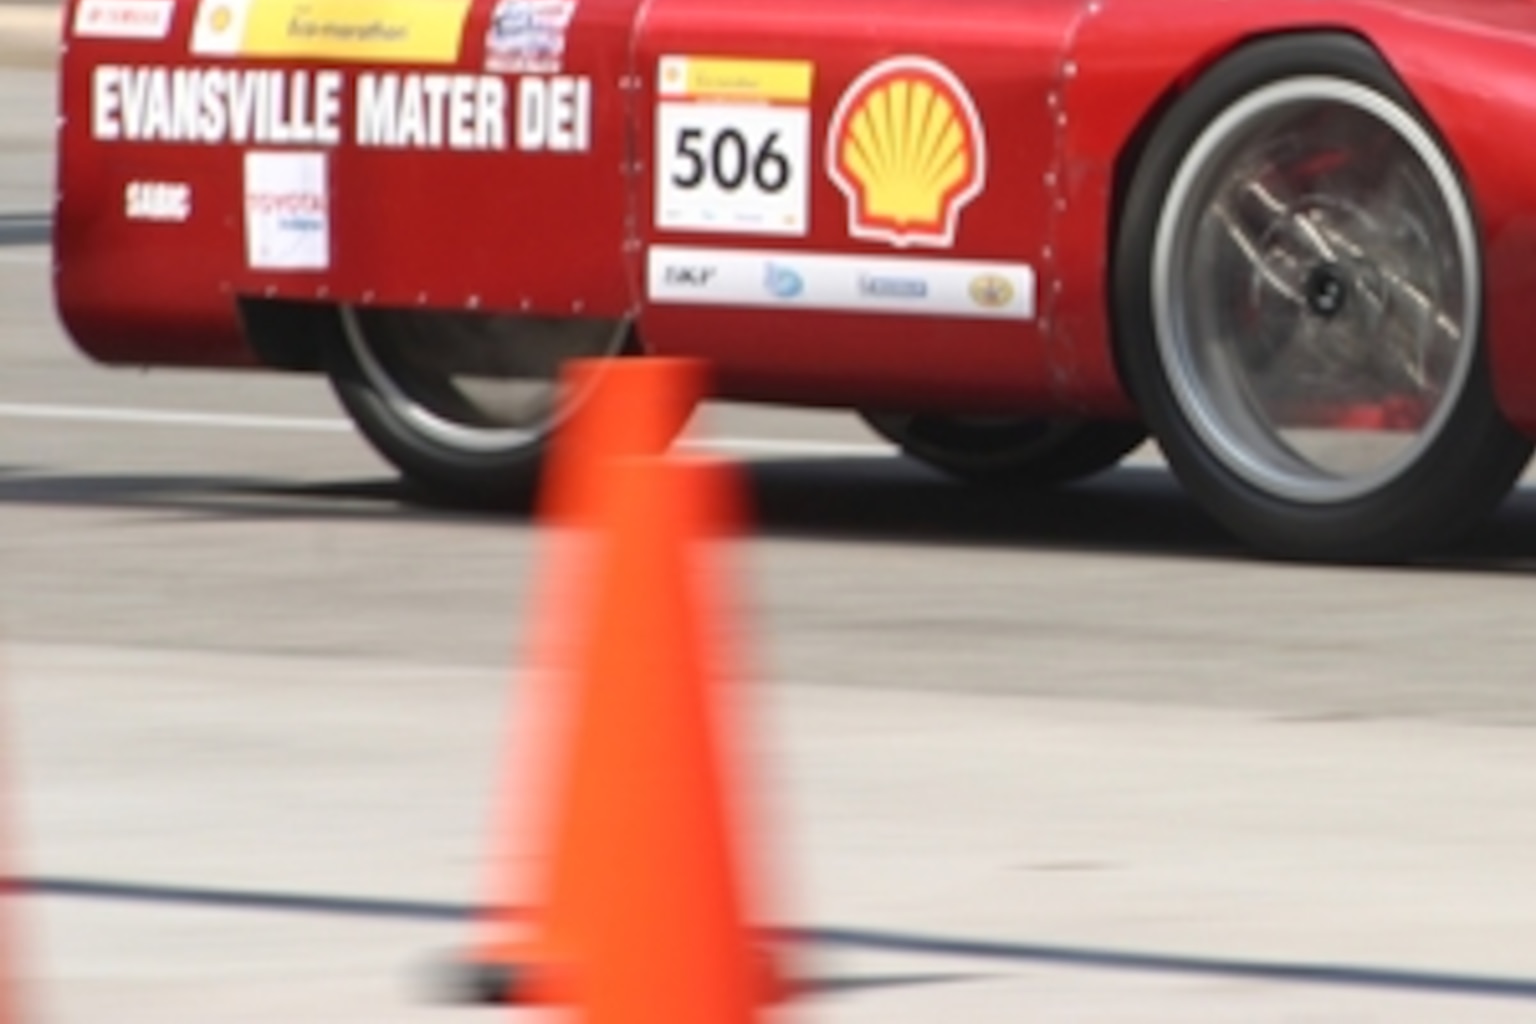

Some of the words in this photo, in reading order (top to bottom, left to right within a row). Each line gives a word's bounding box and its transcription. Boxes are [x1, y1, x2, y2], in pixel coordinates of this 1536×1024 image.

[92, 65, 341, 144] EVANSVILLE
[356, 73, 507, 150] MATER
[517, 76, 592, 151] DEI
[671, 126, 791, 194] 506
